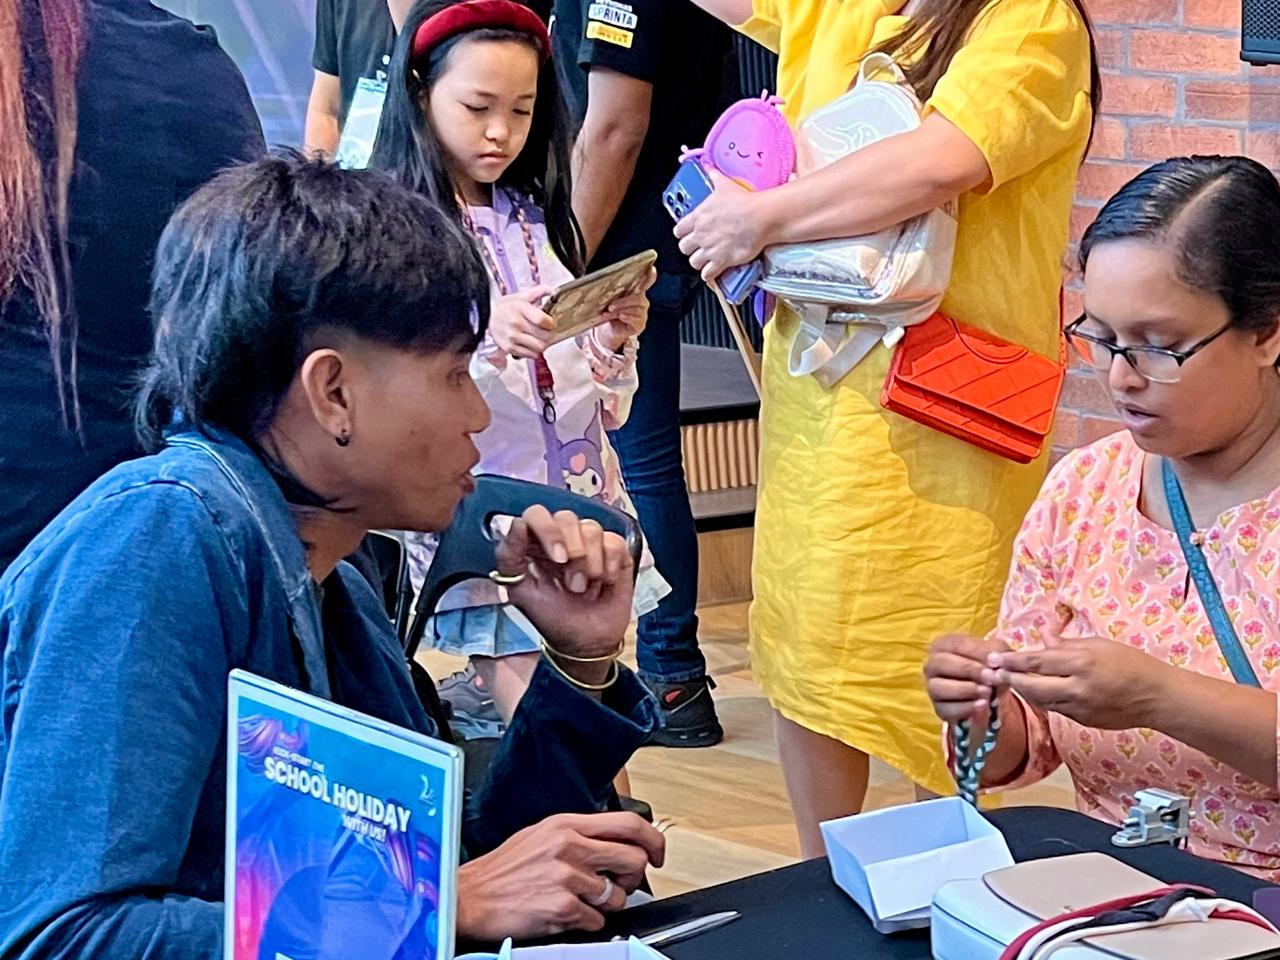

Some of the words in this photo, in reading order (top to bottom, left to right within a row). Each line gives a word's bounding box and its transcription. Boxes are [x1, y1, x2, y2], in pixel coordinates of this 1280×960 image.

[593, 6, 633, 26] SPRINTA
[264, 756, 331, 803] SCHOOL
[333, 782, 411, 833] HOLIDAY
[342, 814, 368, 835] WITH
[368, 824, 387, 843] US!
